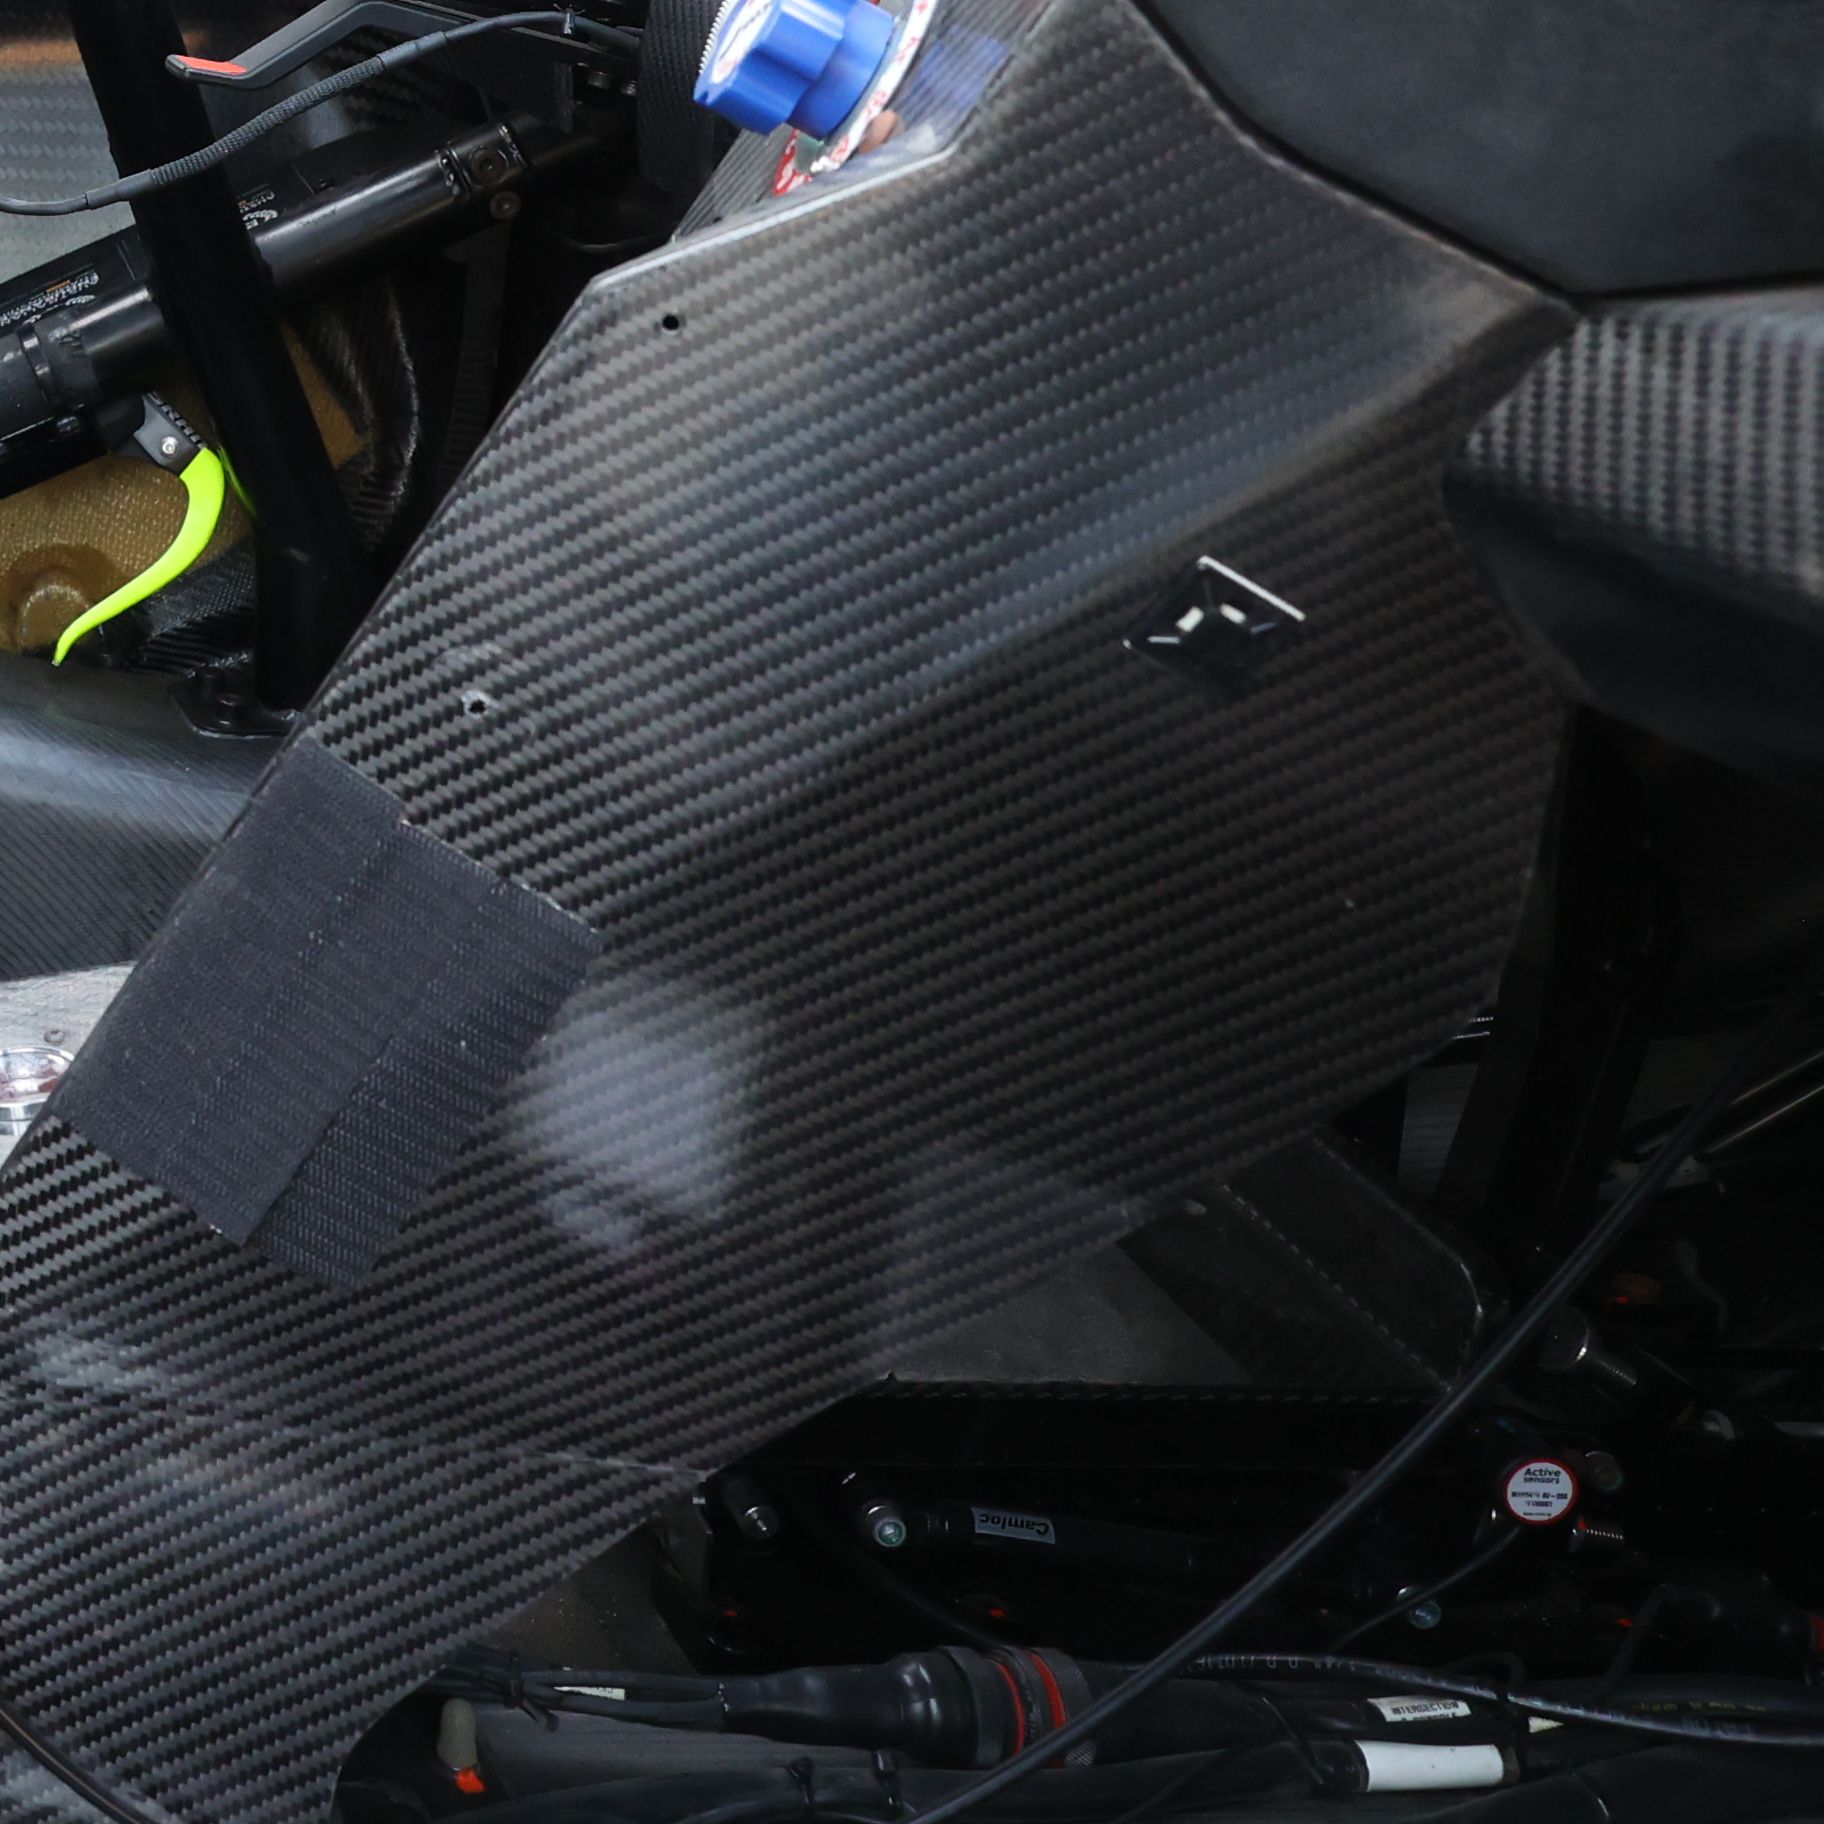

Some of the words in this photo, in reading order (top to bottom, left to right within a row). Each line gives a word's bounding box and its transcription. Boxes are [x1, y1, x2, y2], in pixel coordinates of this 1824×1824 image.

[1524, 1467, 1561, 1477] Active
[1523, 1476, 1560, 1484] sensors
[978, 1512, 1050, 1537] Camloc
